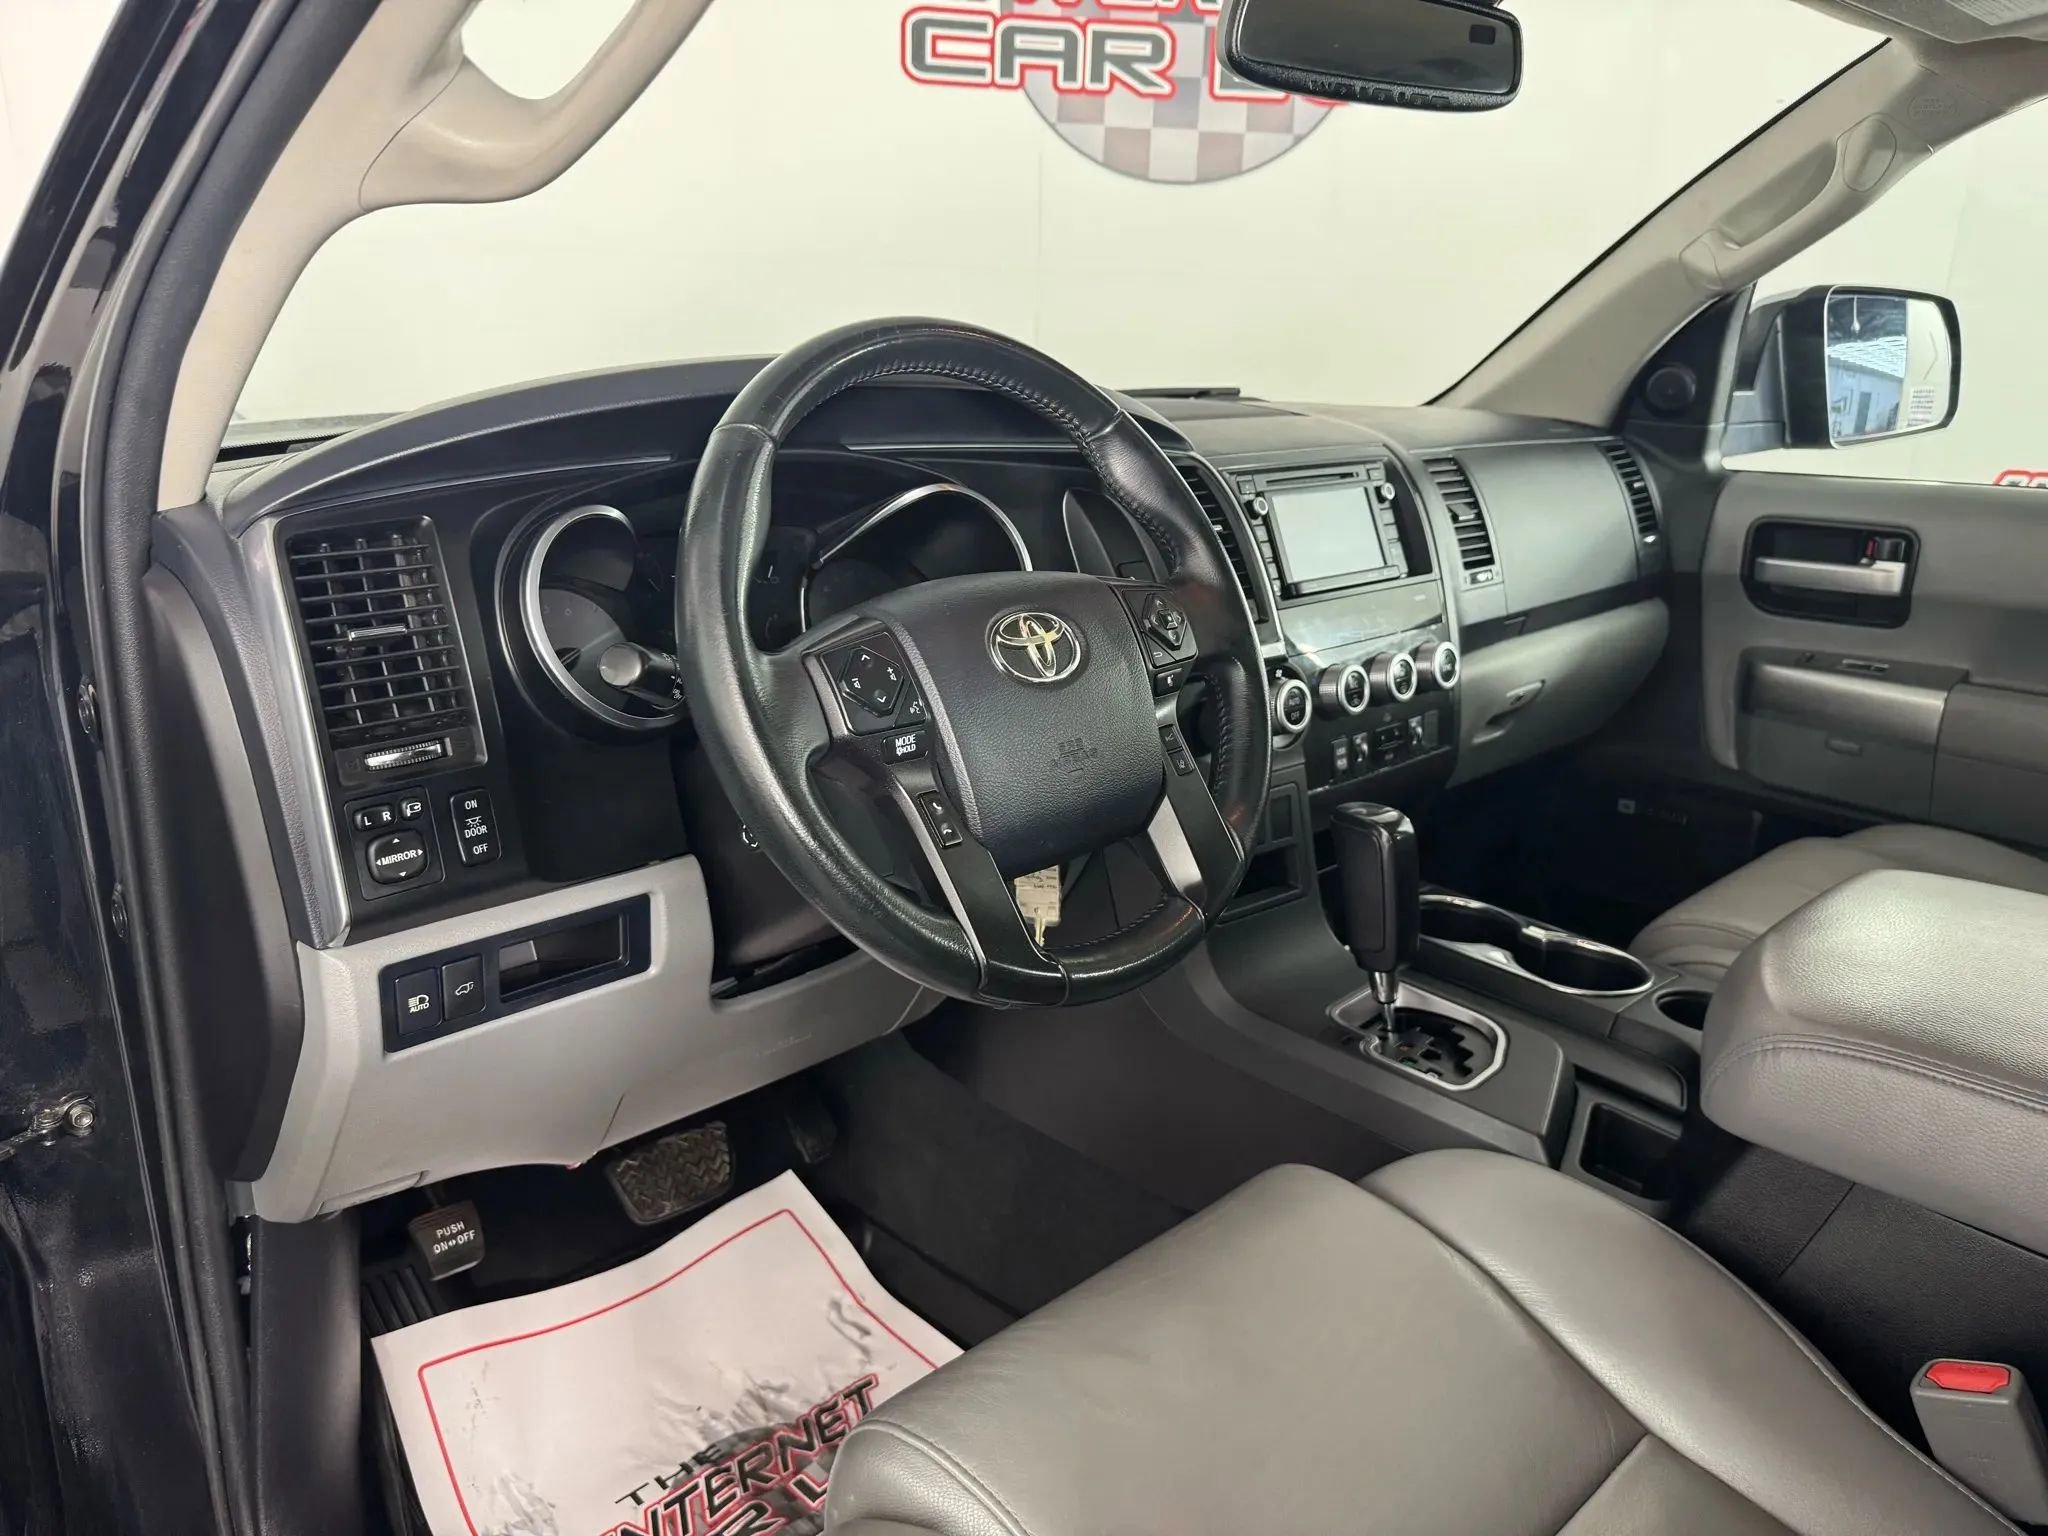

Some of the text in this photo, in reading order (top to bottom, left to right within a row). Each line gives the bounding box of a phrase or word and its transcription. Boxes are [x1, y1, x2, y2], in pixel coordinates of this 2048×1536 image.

[902, 7, 1177, 97] CAR
[895, 733, 917, 748] MODE
[464, 799, 478, 810] ON
[364, 811, 392, 826] L R
[464, 825, 488, 839] DOOR
[472, 843, 489, 855] OFF
[381, 849, 417, 866] MIRROR
[410, 1003, 430, 1013] AUTO
[436, 1221, 465, 1239] PUSH
[614, 1444, 722, 1506] THE
